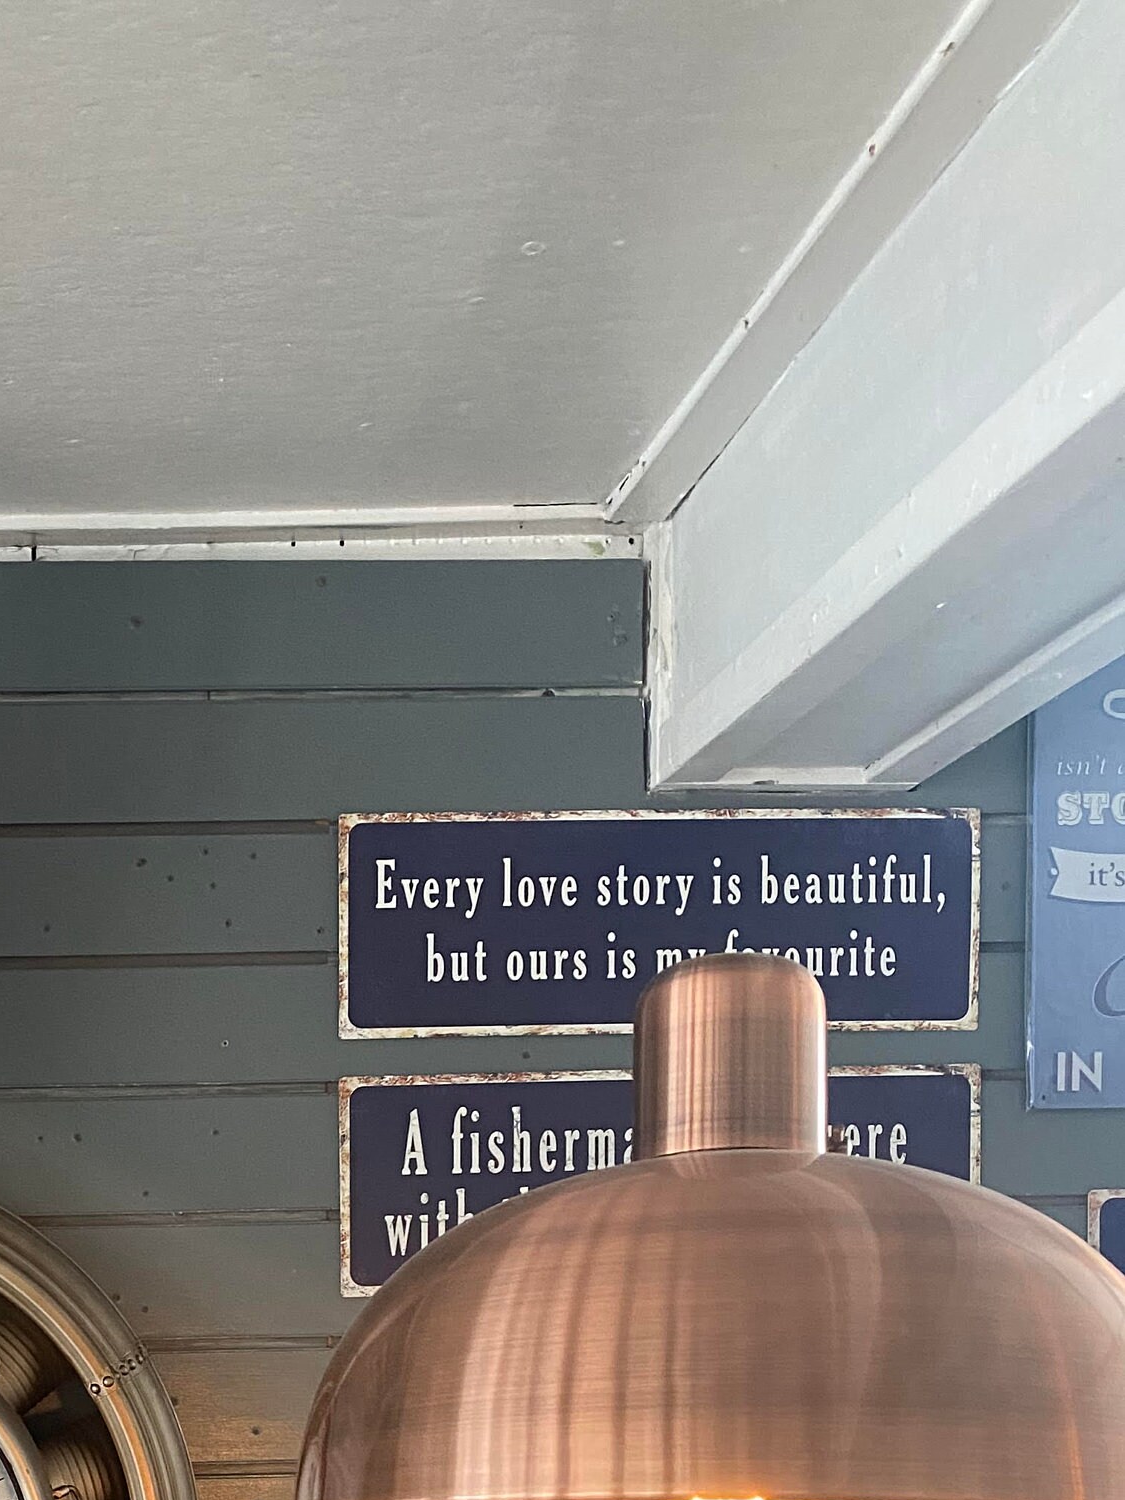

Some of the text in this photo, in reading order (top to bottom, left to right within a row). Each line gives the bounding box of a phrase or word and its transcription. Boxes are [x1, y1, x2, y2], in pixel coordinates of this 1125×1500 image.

[1057, 755, 1106, 776] isn't
[375, 854, 946, 918] Every love story is beautiful,
[426, 929, 897, 982] but ours is m furite
[1057, 1051, 1103, 1092] IN
[401, 1108, 428, 1175] A
[828, 1123, 907, 1165] ere
